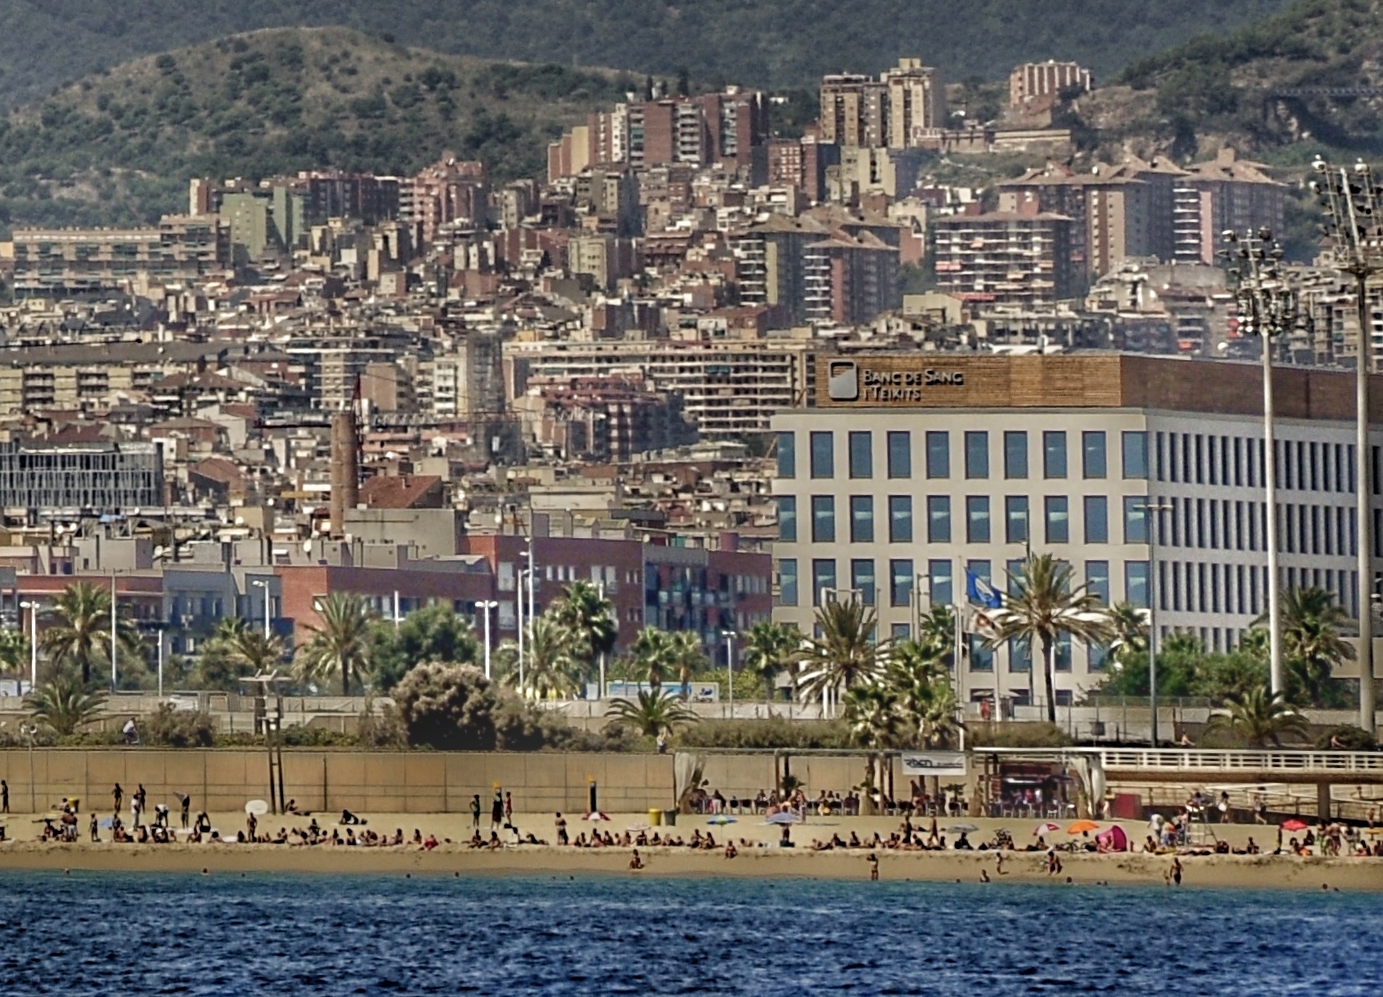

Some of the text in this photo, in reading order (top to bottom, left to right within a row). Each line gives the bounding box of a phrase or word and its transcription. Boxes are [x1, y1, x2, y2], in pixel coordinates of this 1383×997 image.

[863, 368, 902, 385] BANC
[924, 368, 964, 385] SANG
[871, 385, 921, 401] TEIXITS
